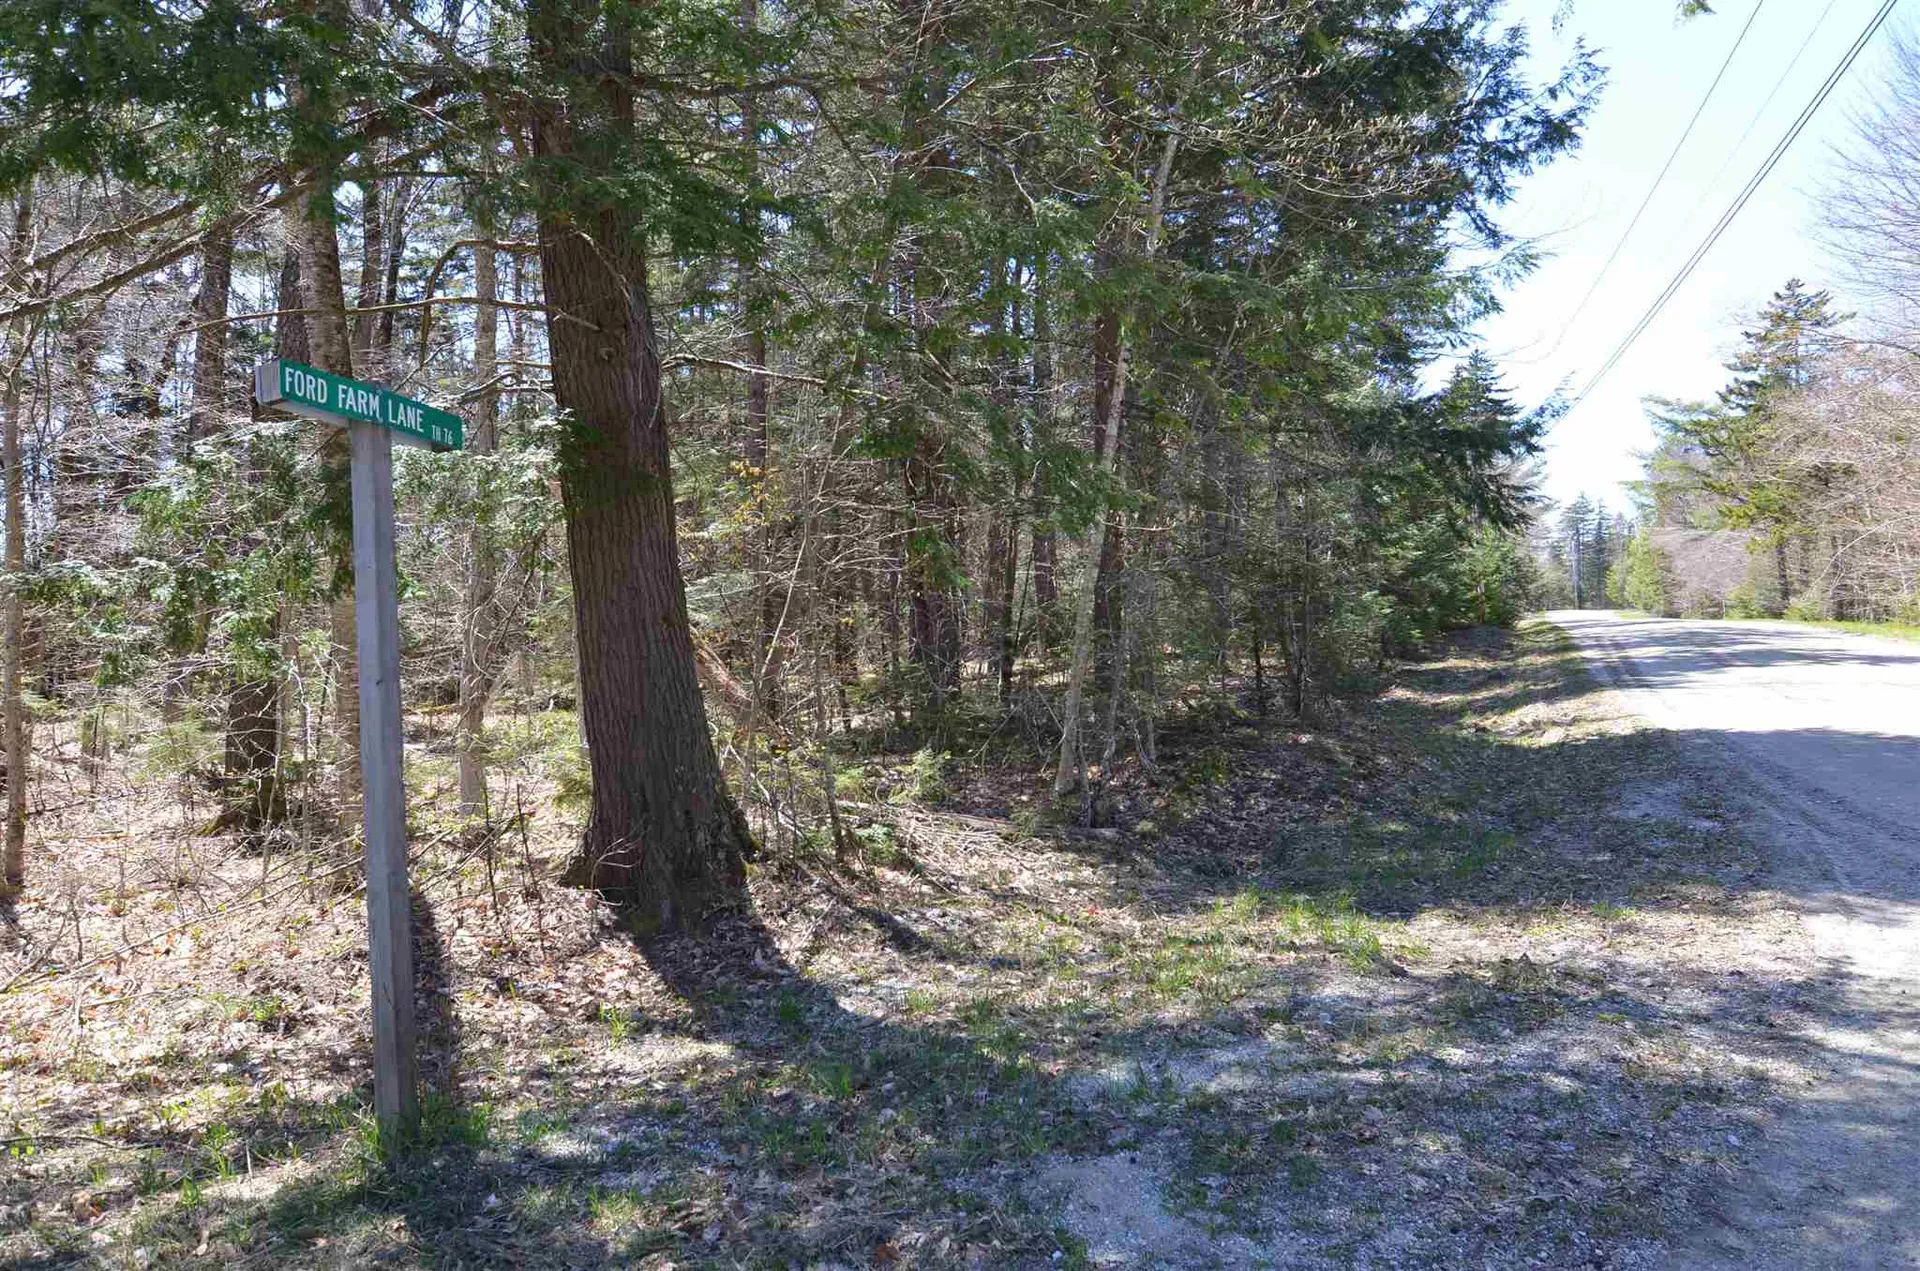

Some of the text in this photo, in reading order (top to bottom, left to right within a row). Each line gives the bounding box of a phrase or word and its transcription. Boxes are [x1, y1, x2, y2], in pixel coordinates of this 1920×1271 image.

[285, 367, 453, 445] FORD FARM LANE TH 76
